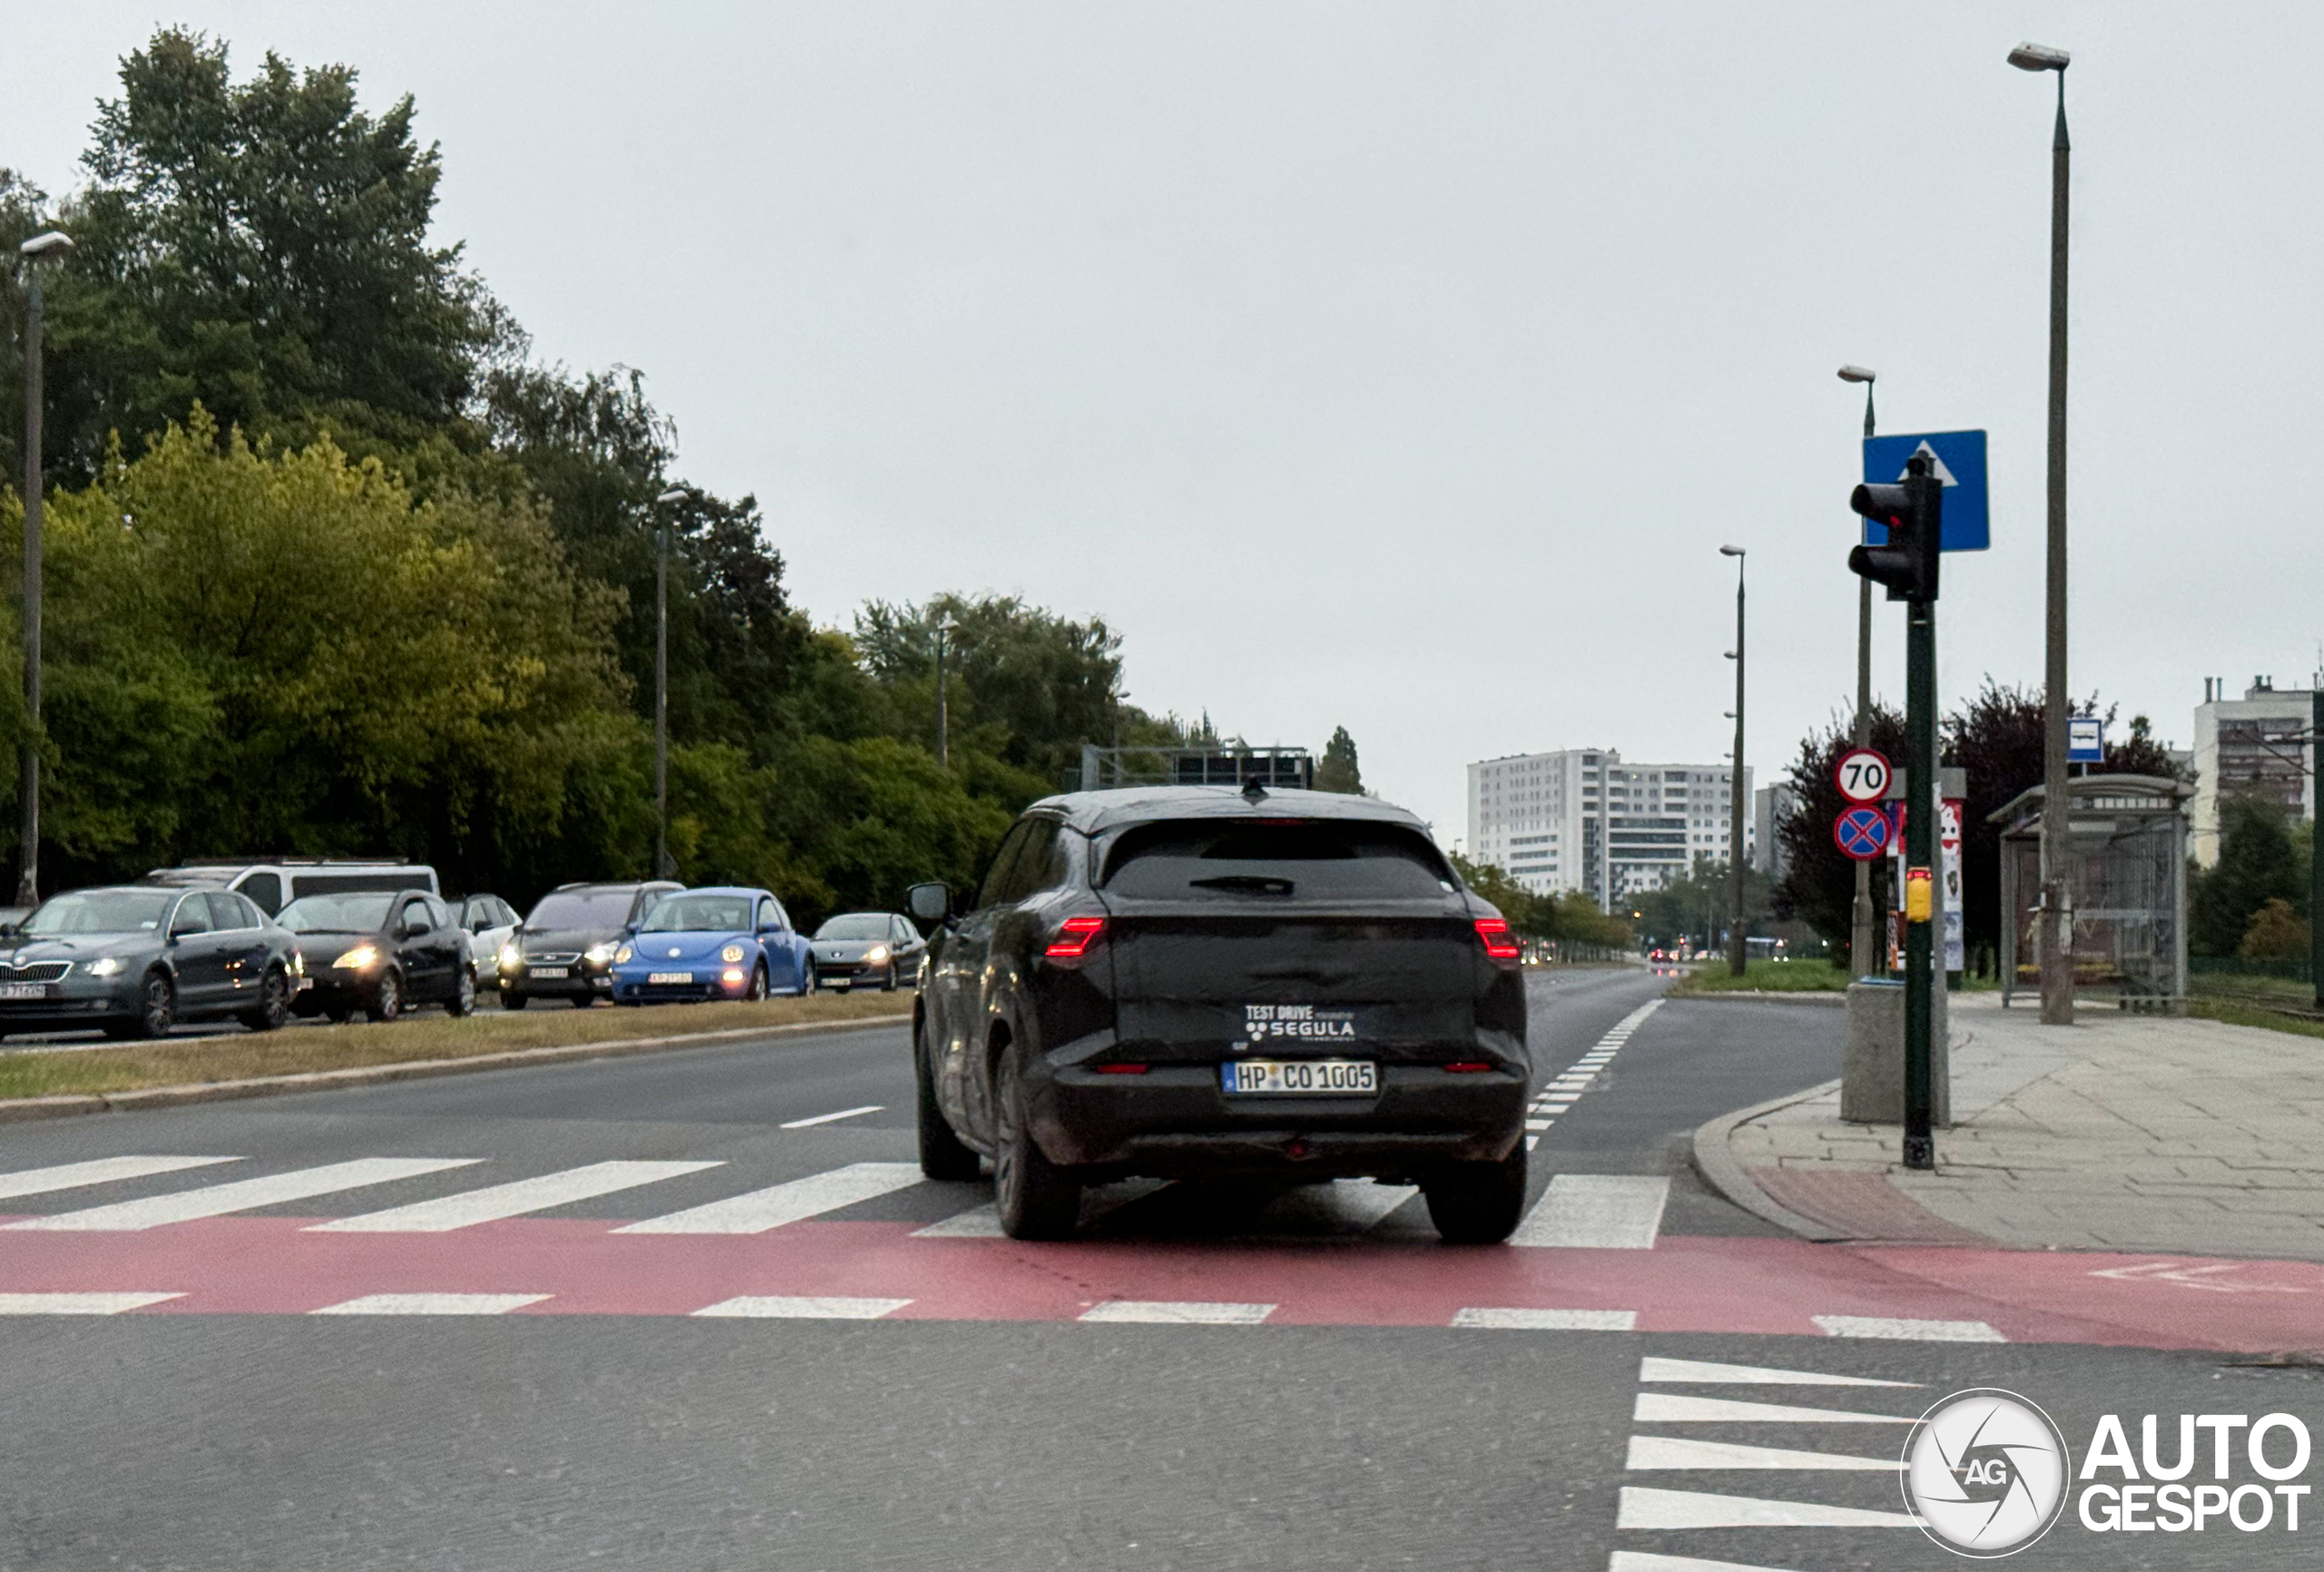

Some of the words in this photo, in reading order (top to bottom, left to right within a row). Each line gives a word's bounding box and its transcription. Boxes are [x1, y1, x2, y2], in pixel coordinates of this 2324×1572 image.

[1846, 763, 1883, 791] 70
[1246, 1005, 1275, 1020] TEST
[1277, 1005, 1314, 1020] DRIVE
[1270, 1021, 1354, 1036] SEGULA
[1237, 1066, 1266, 1089] HP
[1284, 1065, 1313, 1089] CO
[1317, 1065, 1373, 1089] 1005
